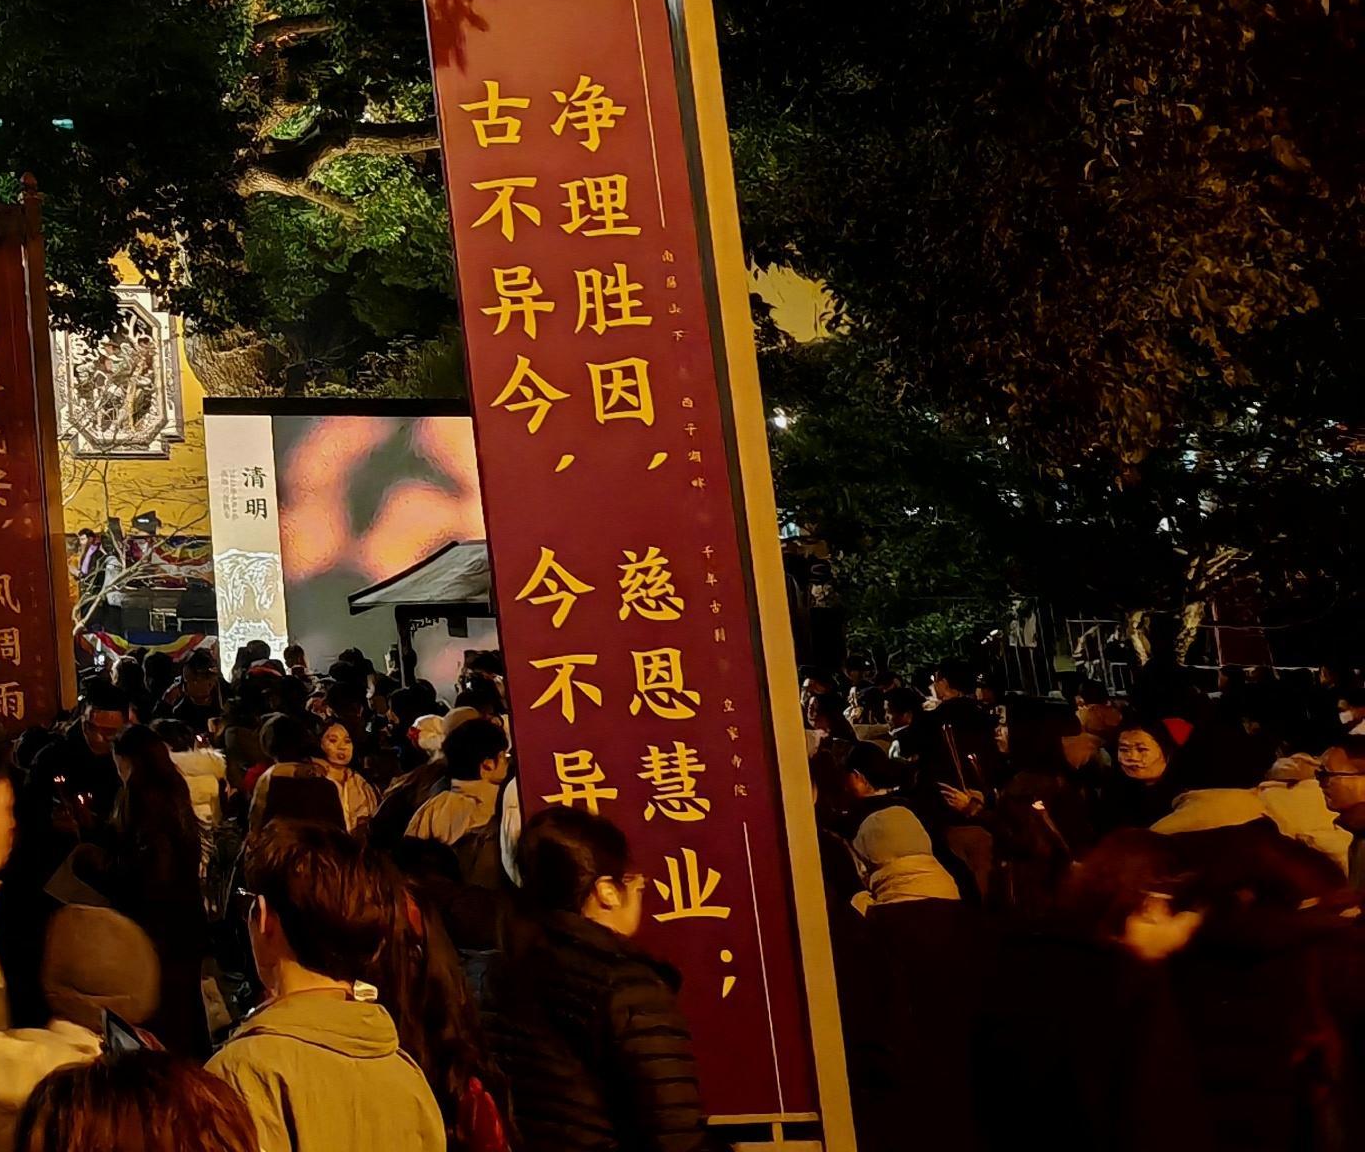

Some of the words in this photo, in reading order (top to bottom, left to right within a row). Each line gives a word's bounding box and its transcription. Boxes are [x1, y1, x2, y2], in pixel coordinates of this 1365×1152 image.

[459, 80, 576, 472] 古不异今，
[242, 466, 268, 521] 清明
[550, 75, 668, 472] 净理胜因，
[618, 547, 738, 998] 慈恩慧业；
[514, 546, 618, 815] 今不异
